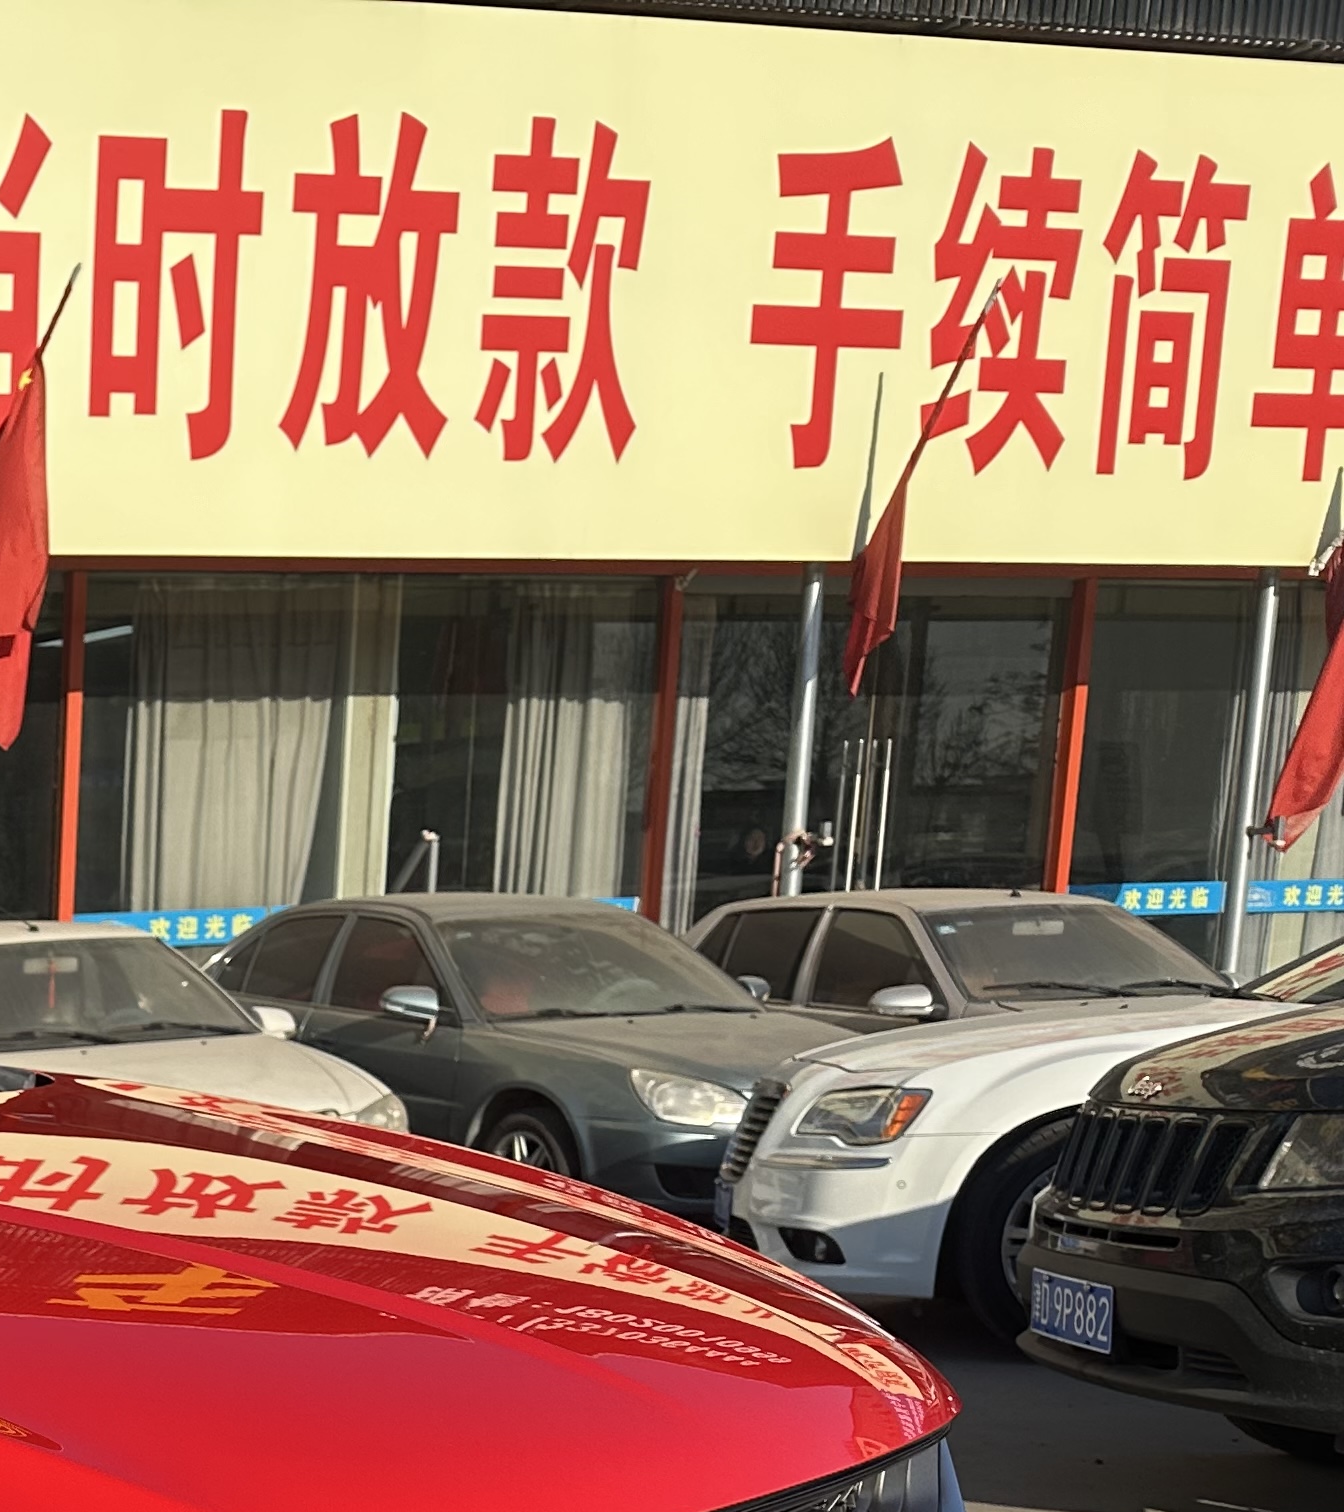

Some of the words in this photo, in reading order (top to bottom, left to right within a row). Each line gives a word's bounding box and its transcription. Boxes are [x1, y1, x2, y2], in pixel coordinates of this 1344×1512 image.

[1123, 886, 1210, 909] 欢迎光临
[149, 914, 253, 941] 欢迎光临
